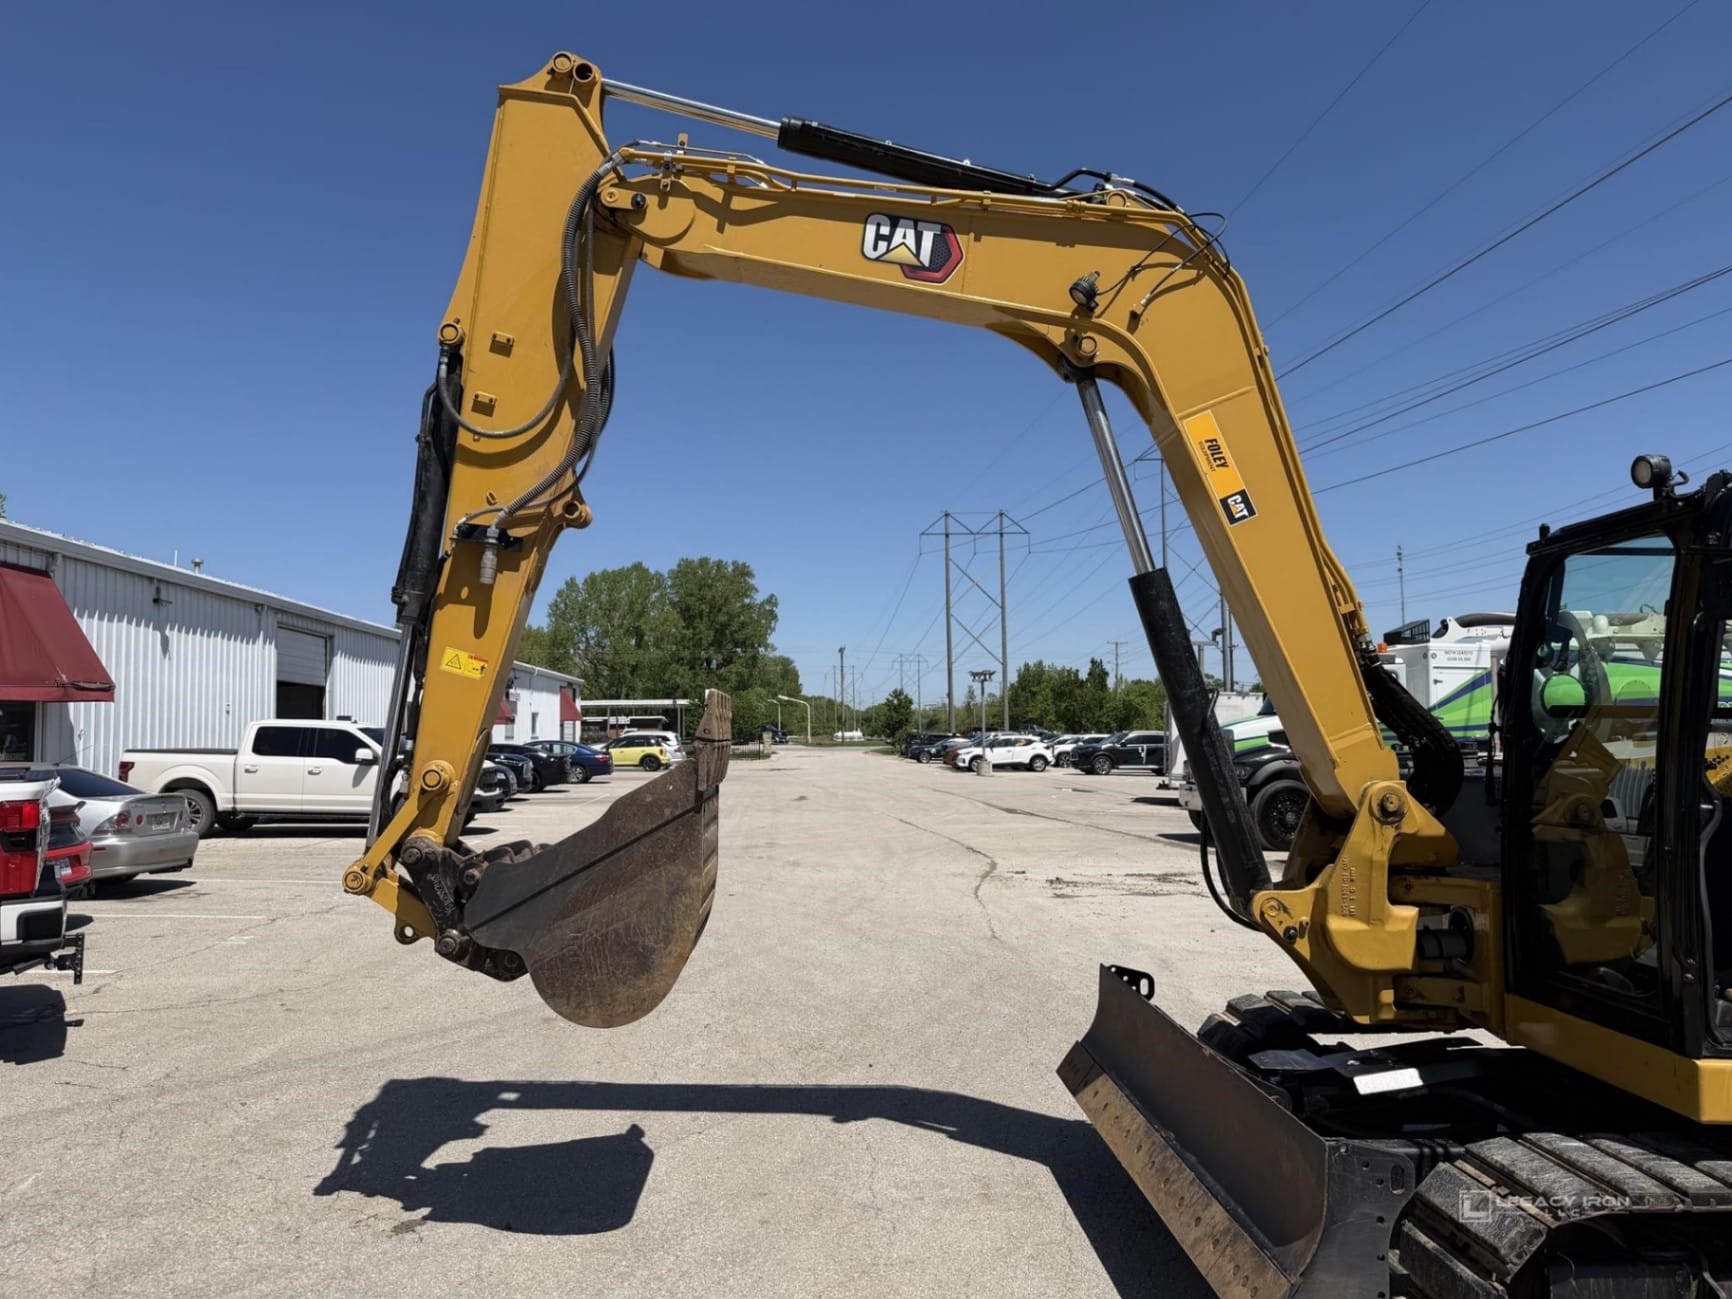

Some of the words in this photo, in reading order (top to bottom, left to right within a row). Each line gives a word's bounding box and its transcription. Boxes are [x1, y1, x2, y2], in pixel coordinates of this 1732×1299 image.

[863, 214, 941, 268] CAT
[1198, 441, 1216, 472] EQUIPMENT
[1204, 438, 1229, 469] FOLEY
[1227, 494, 1250, 519] CAT
